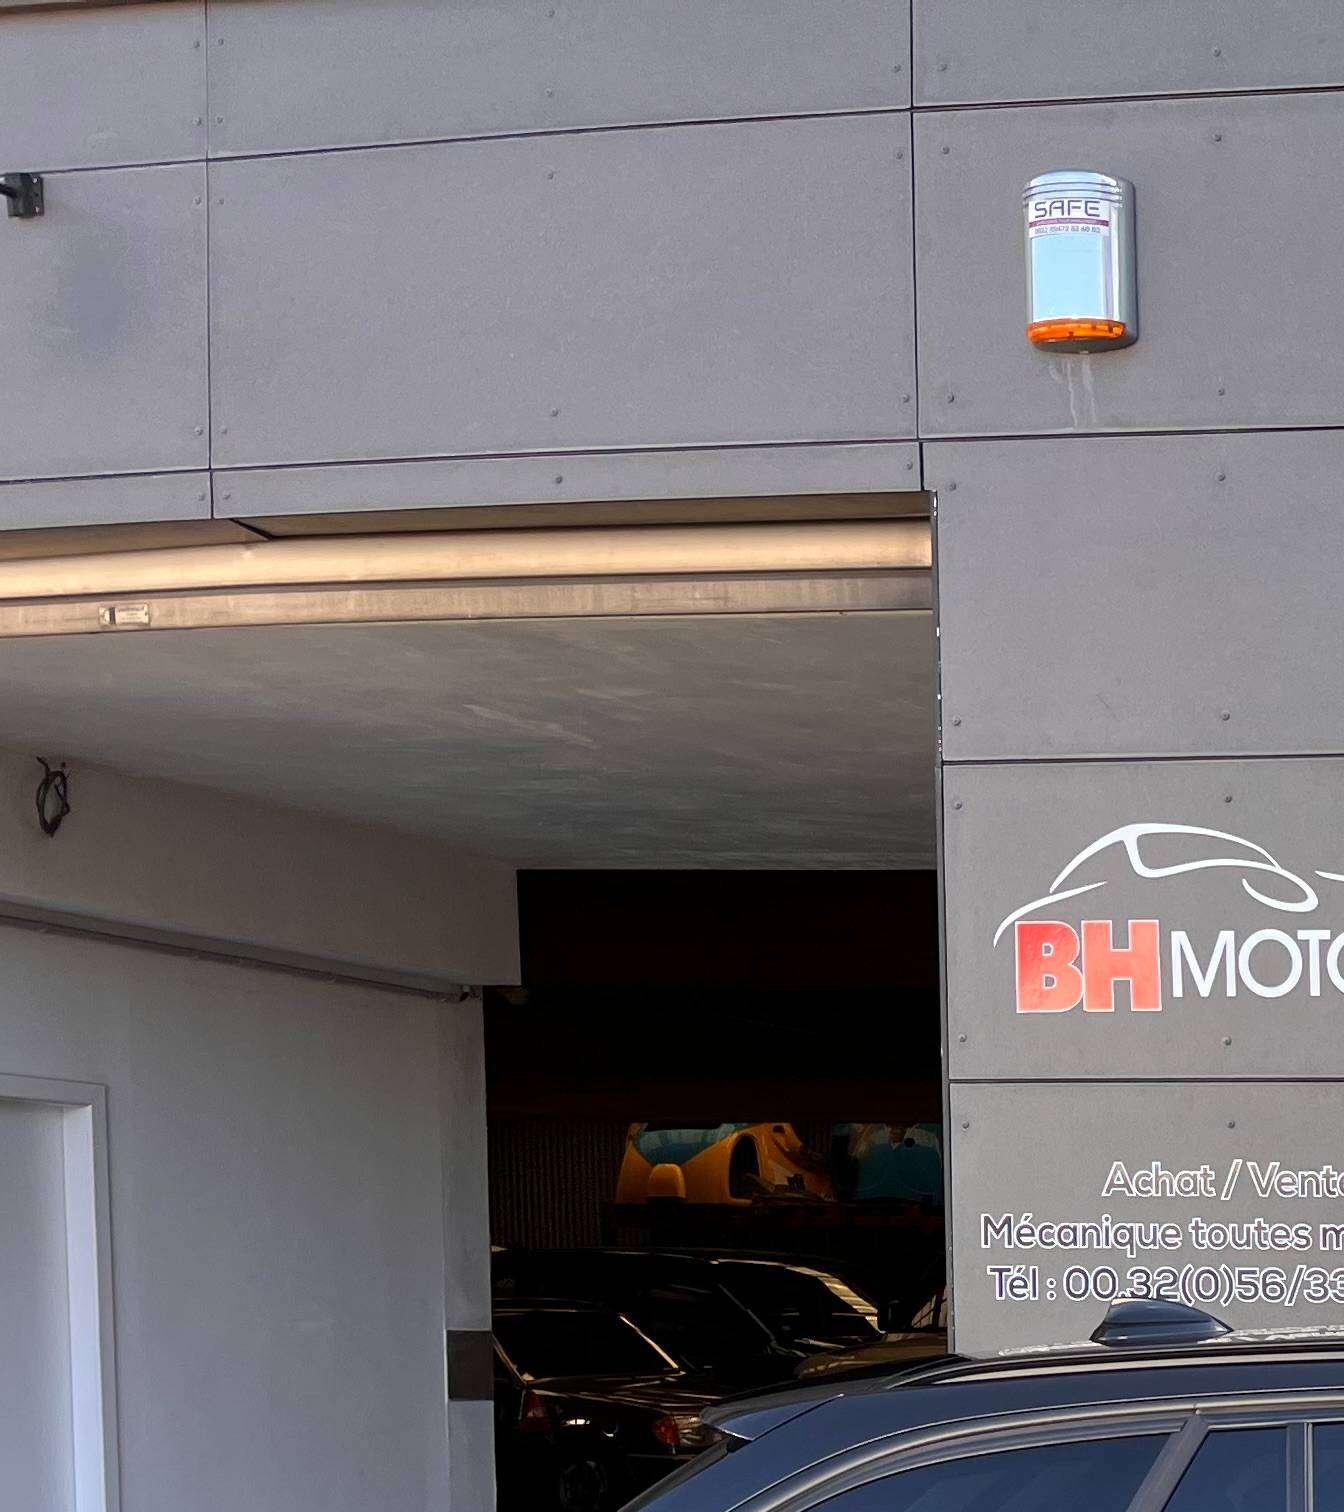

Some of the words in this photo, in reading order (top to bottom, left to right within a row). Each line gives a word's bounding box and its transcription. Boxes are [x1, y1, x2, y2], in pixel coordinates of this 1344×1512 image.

[1034, 200, 1101, 219] SAFE
[1015, 920, 1162, 1013] BH
[1102, 1160, 1216, 1198] Achat
[980, 1214, 1182, 1258] Mécanique
[1189, 1217, 1313, 1250] toutes
[988, 1265, 1038, 1302] Tél
